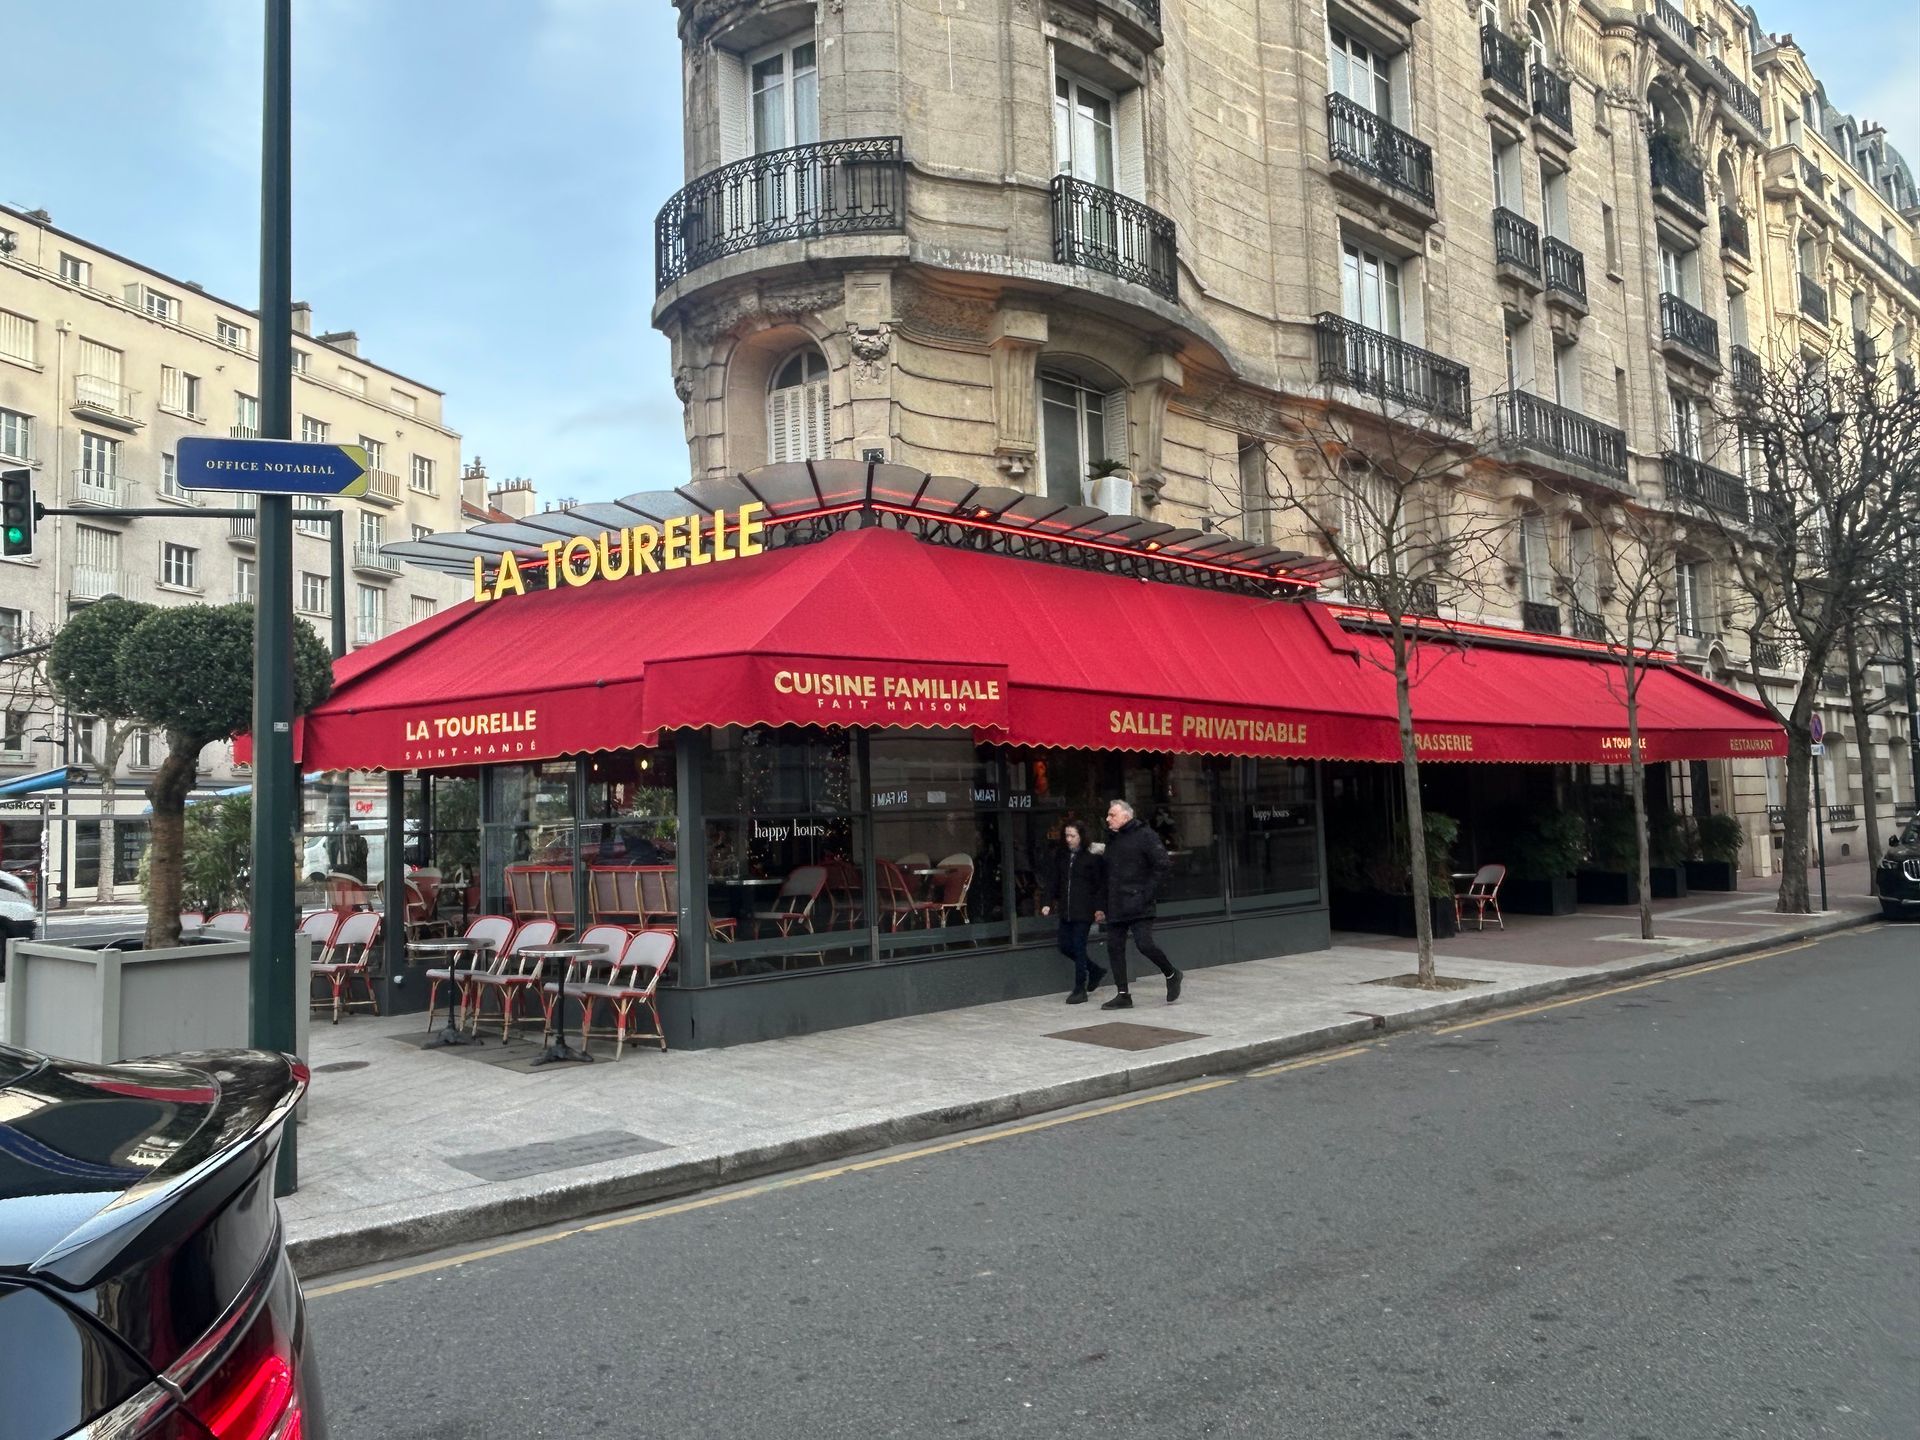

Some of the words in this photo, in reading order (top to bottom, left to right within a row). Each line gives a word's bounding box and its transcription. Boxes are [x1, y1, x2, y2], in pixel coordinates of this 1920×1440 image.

[206, 460, 259, 471] OFFICE
[264, 463, 335, 475] NOTARIAL
[474, 550, 525, 602] LA
[542, 501, 763, 590] TOURELLE
[774, 671, 877, 697] CUISINE
[883, 677, 1000, 700] FAMILIALE
[818, 698, 868, 710] FAIT
[887, 701, 966, 712] MAISON
[406, 720, 430, 741] LA
[434, 709, 537, 738] TOURELLE
[1110, 710, 1172, 736] SALLE
[1182, 715, 1307, 744] PRIVATISABLE
[405, 739, 536, 760] SAINT-MANDÉ
[1414, 733, 1473, 752] RASSERIE
[1601, 737, 1612, 749] LA
[1612, 737, 1647, 749] TOURLE
[1730, 739, 1774, 751] RESTAURANT
[0, 801, 56, 810] AGRICOE
[1252, 804, 1271, 821] happy
[1272, 803, 1290, 818] hours
[754, 819, 790, 841] happy
[793, 818, 825, 837] hours
